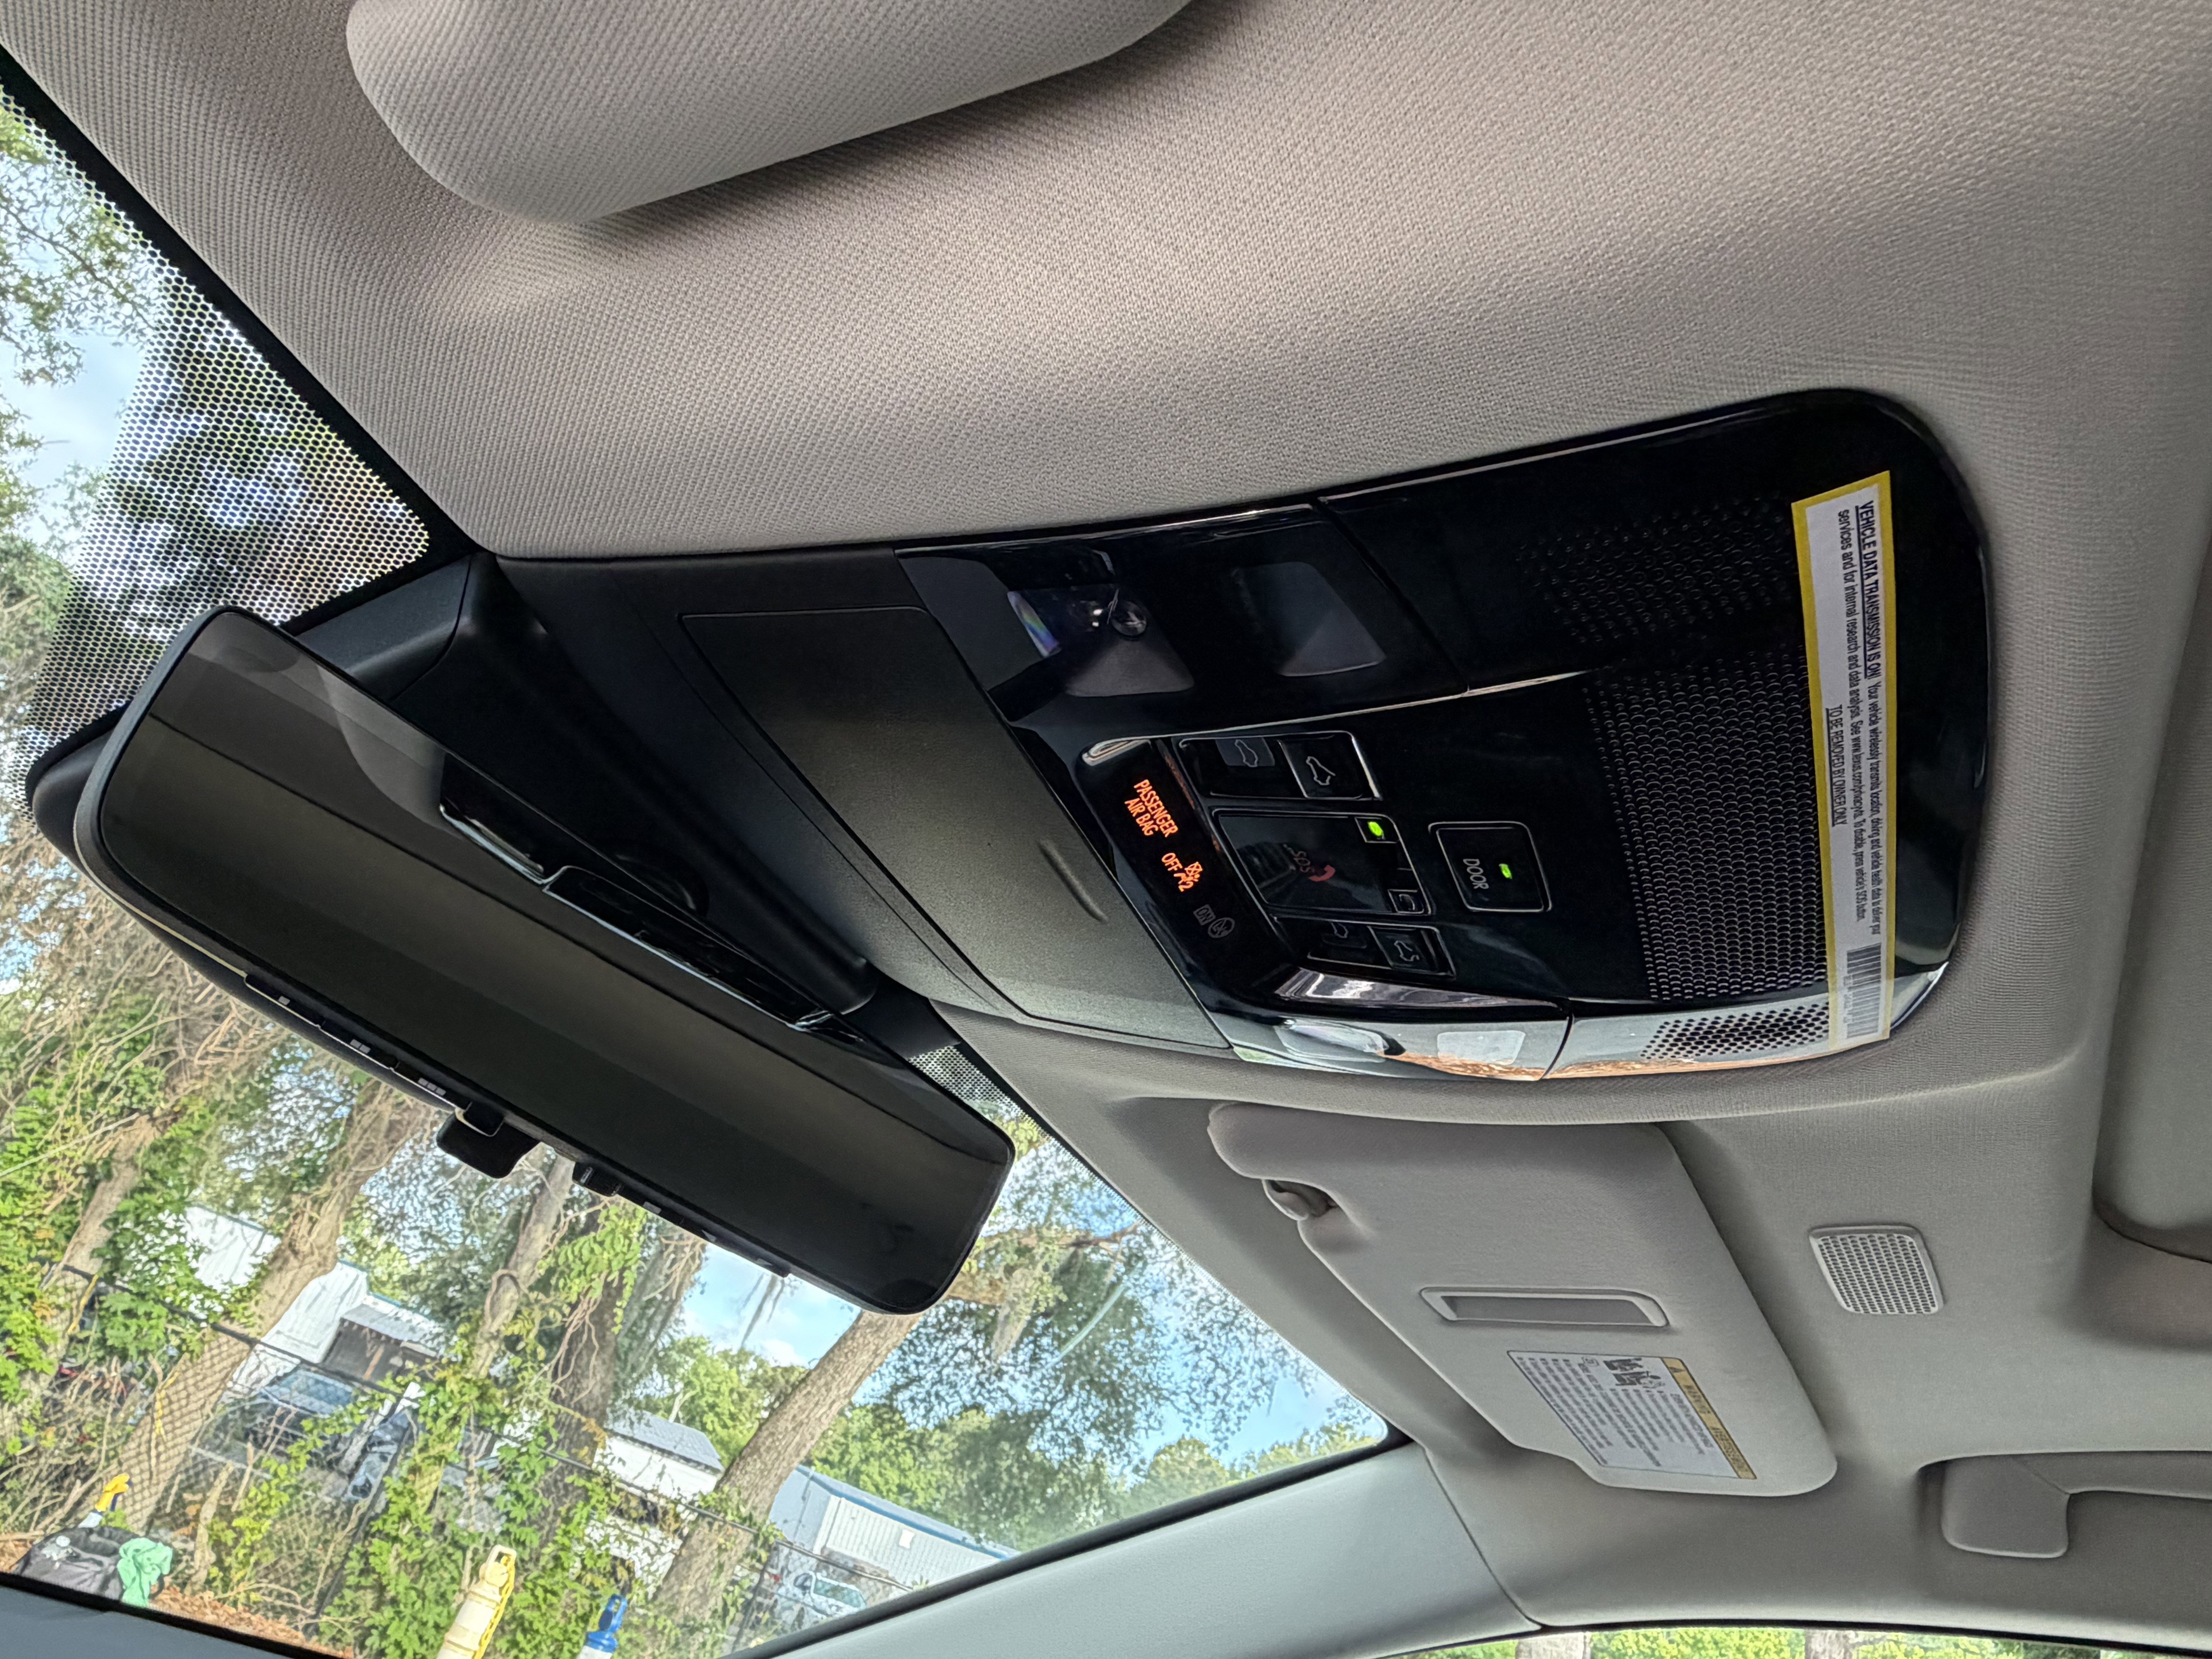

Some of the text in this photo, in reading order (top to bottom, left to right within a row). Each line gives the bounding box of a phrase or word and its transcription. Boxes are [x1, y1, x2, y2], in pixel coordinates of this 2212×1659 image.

[1838, 509, 1855, 550] services
[1859, 500, 1876, 548] VEHICLE
[1841, 552, 1857, 570] and
[1862, 551, 1878, 580] DATA
[1843, 570, 1858, 584] for
[1844, 585, 1859, 617] internal
[1864, 580, 1881, 651] TRANSMISSION
[1846, 618, 1861, 653] research
[1848, 655, 1862, 670] and
[1868, 652, 1881, 661] IS
[1848, 671, 1862, 688] data
[1868, 663, 1881, 679] ON!
[1868, 681, 1881, 701] Your
[1846, 689, 1863, 721] analysis.
[1869, 701, 1882, 726] vehicle
[1850, 721, 1863, 736] See
[1867, 727, 1882, 760] wirelessly
[1829, 704, 1847, 826] TO BE REMOVED BY OWNER ONLY
[1870, 761, 1882, 790] transmits
[1133, 779, 1178, 838] PASSENGER
[1869, 791, 1883, 816] location,
[1124, 798, 1158, 836] AIR BAG
[1854, 818, 1866, 828] To
[1868, 817, 1883, 838] driving
[1871, 839, 1883, 850] and
[1161, 853, 1183, 871] OFF
[1293, 851, 1314, 872] SOS
[1871, 850, 1883, 870] vehicle
[1463, 858, 1489, 889] DOOR
[1856, 890, 1867, 903] SOS
[1196, 908, 1214, 923] ON
